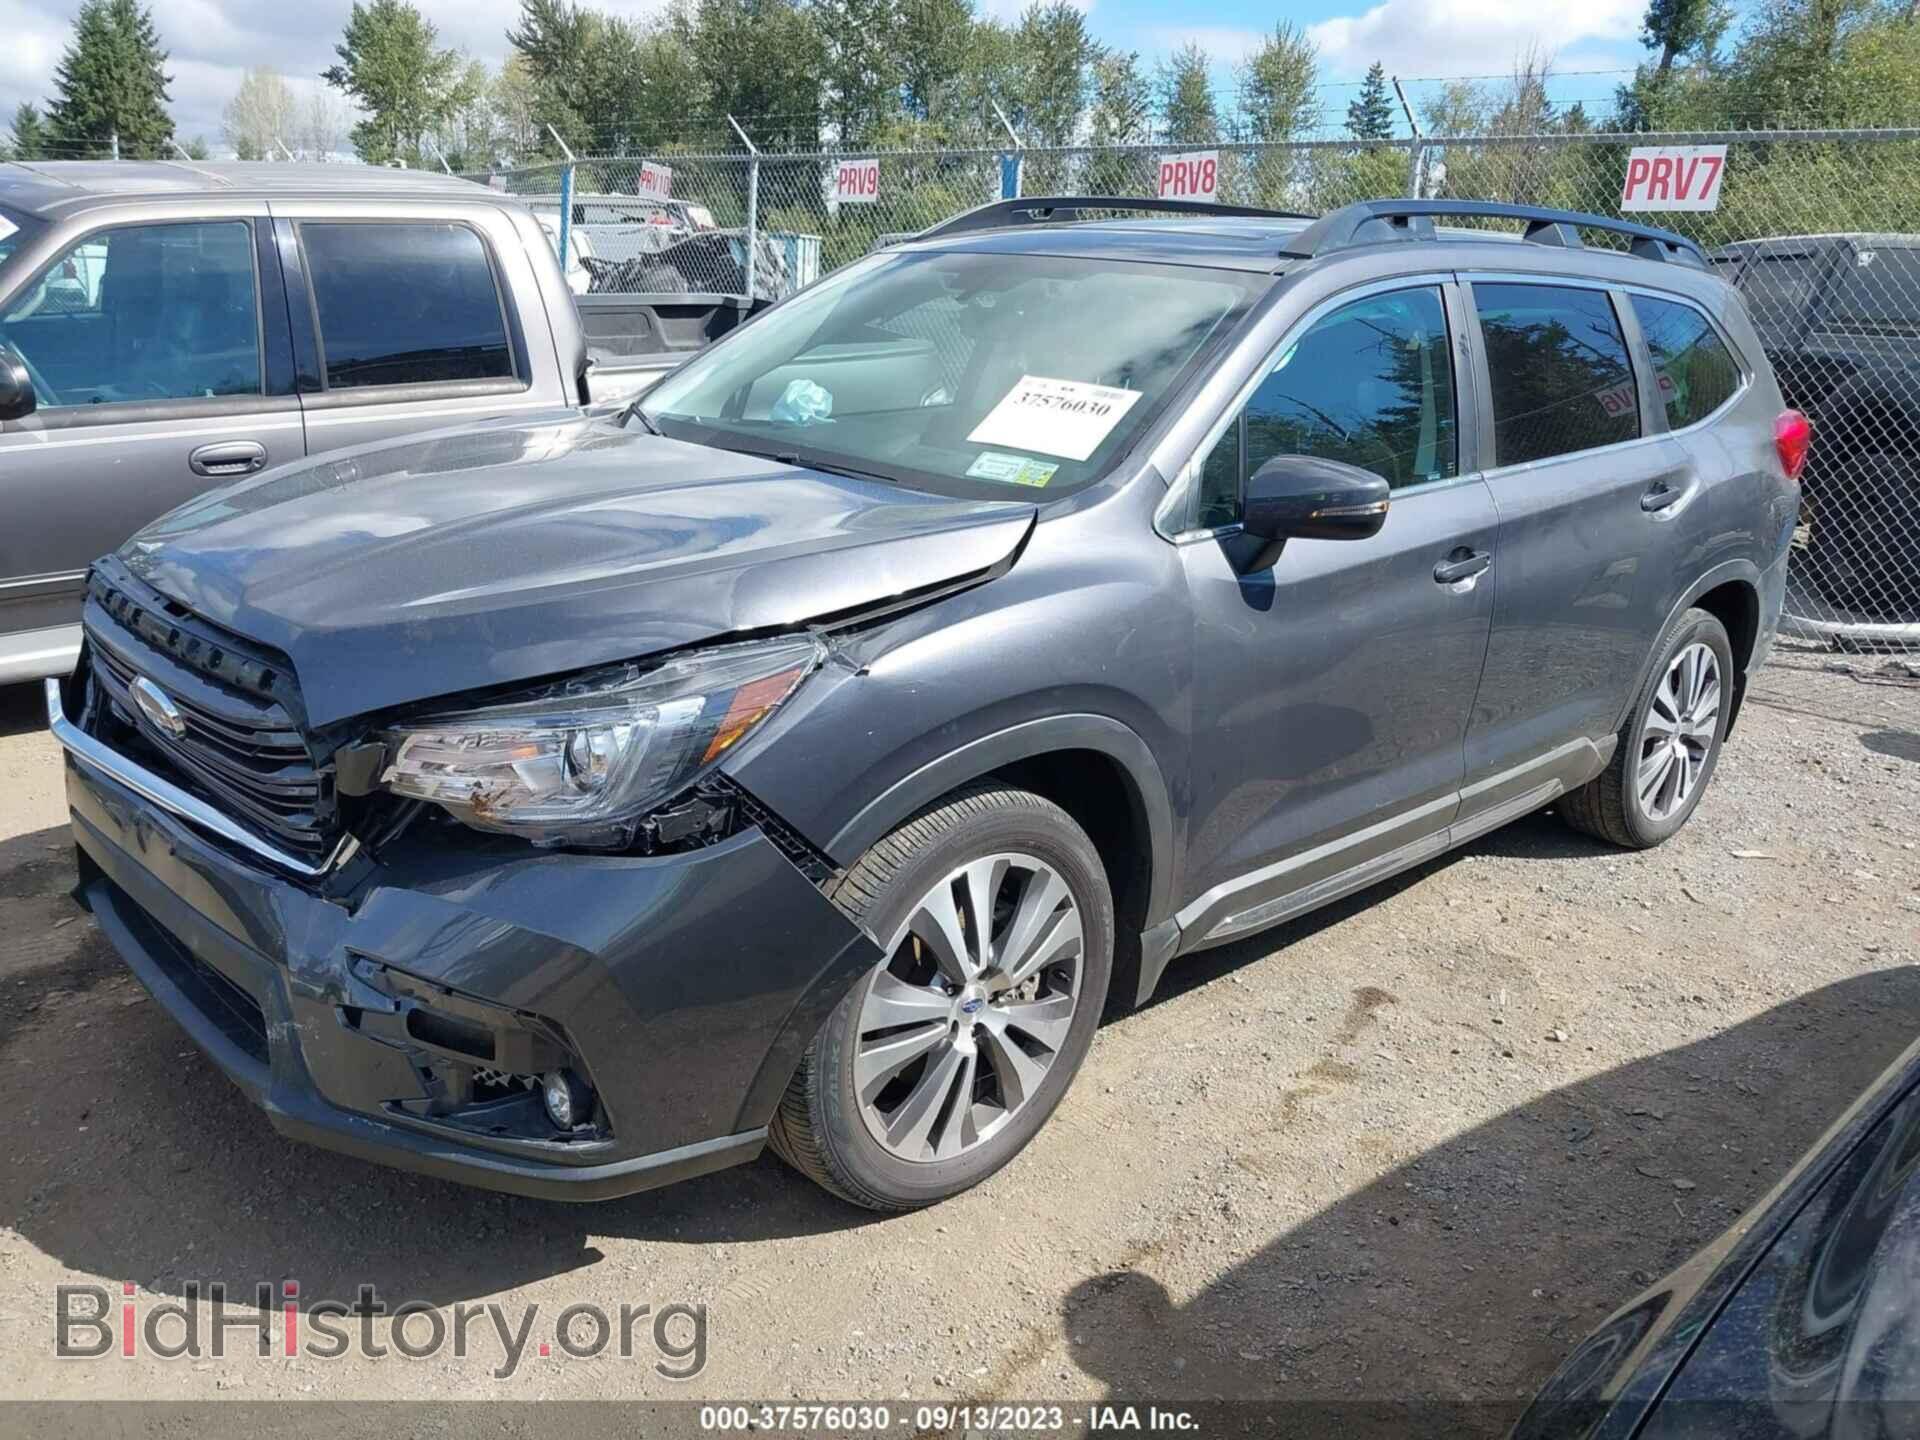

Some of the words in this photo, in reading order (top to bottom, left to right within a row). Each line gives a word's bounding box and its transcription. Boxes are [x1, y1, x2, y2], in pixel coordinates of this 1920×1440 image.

[641, 169, 671, 195] PRV10
[839, 166, 876, 195] PRV9
[1160, 159, 1216, 196] PRV8
[1625, 156, 1722, 200] PRV7
[1013, 391, 1112, 417] 37576030
